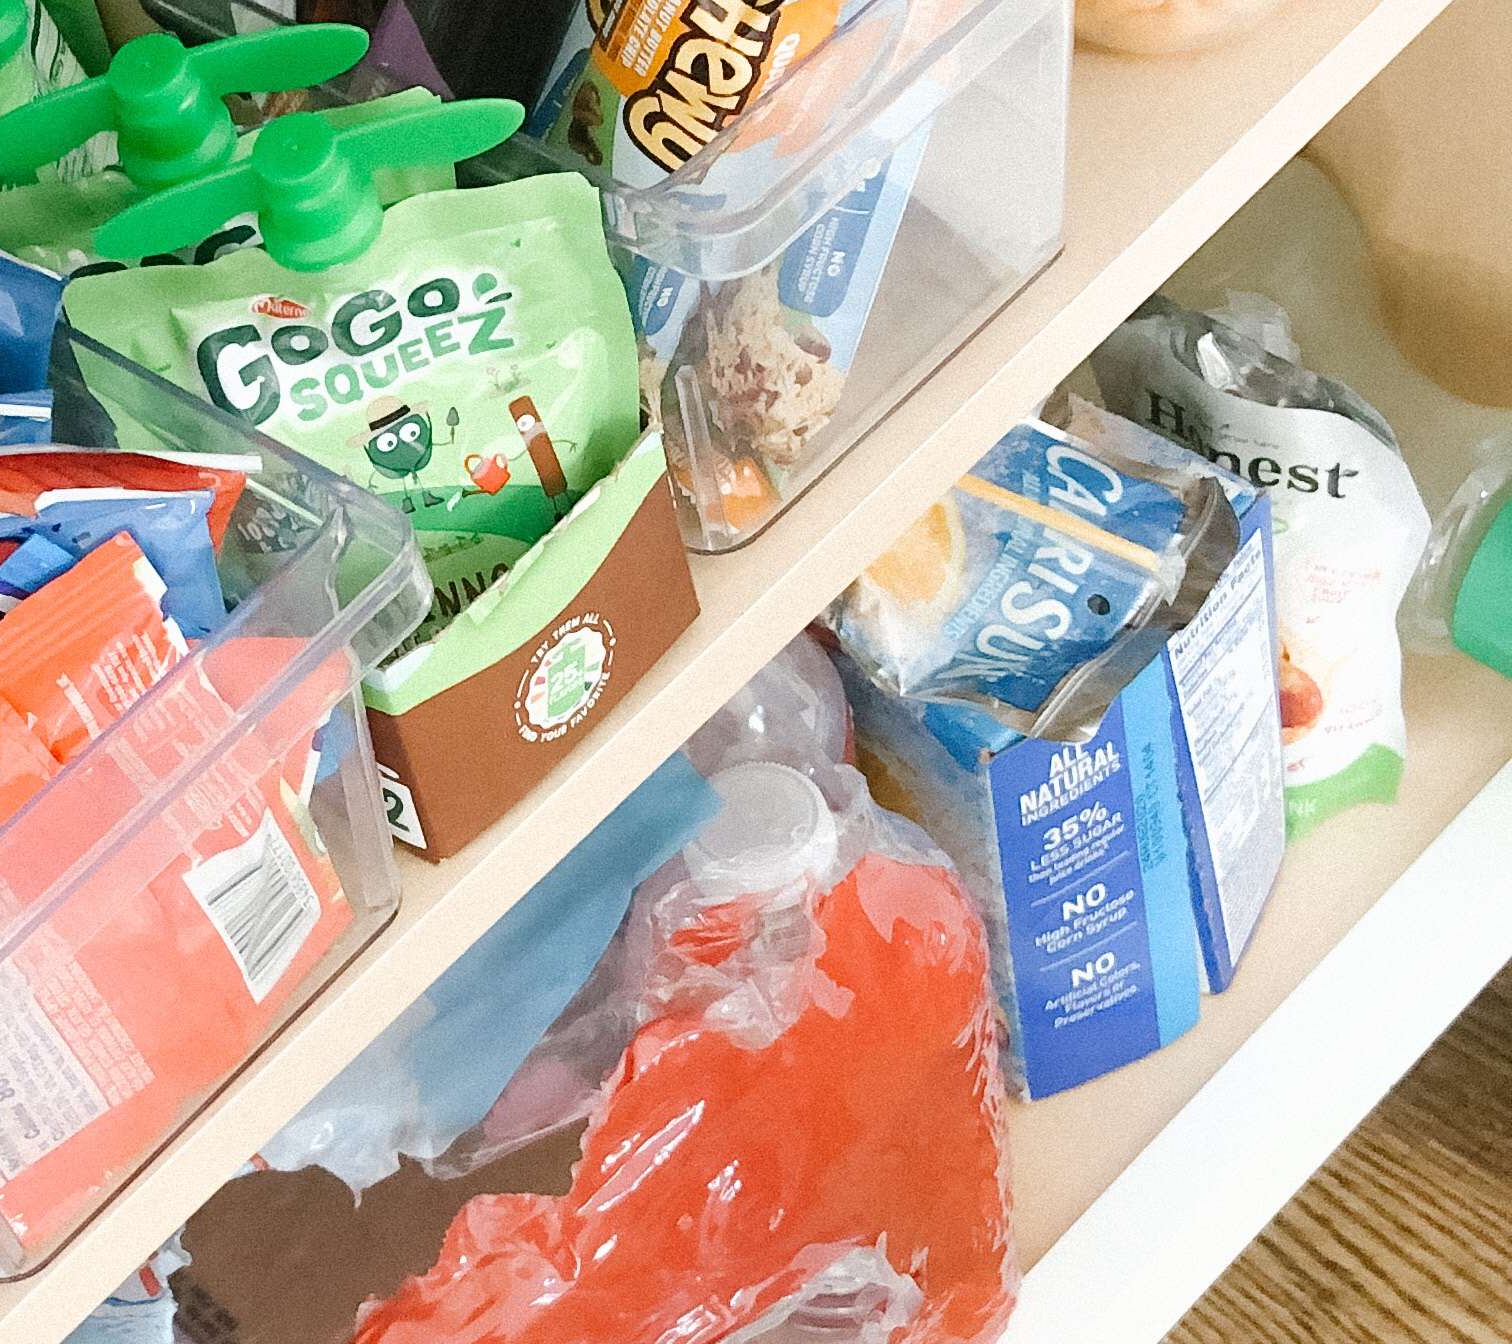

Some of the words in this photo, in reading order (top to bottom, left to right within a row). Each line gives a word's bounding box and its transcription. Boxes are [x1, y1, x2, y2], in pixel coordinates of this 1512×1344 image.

[826, 250, 847, 278] NO
[288, 304, 516, 424] SQUEEZ
[530, 640, 551, 665] TRY
[551, 619, 583, 642] THEM
[581, 611, 601, 628] ALL
[569, 668, 613, 730] FAVORITE
[1020, 741, 1120, 816] NATURAL
[1050, 742, 1089, 777] ALL
[1021, 761, 1120, 826] INGREDIENTS
[1043, 801, 1107, 850] 35%
[1035, 925, 1070, 947] High
[1073, 889, 1135, 930] Fructose
[1062, 882, 1106, 921] NO
[1046, 928, 1083, 953] Corn
[1086, 907, 1127, 937] Syrup
[1072, 951, 1115, 987] NO
